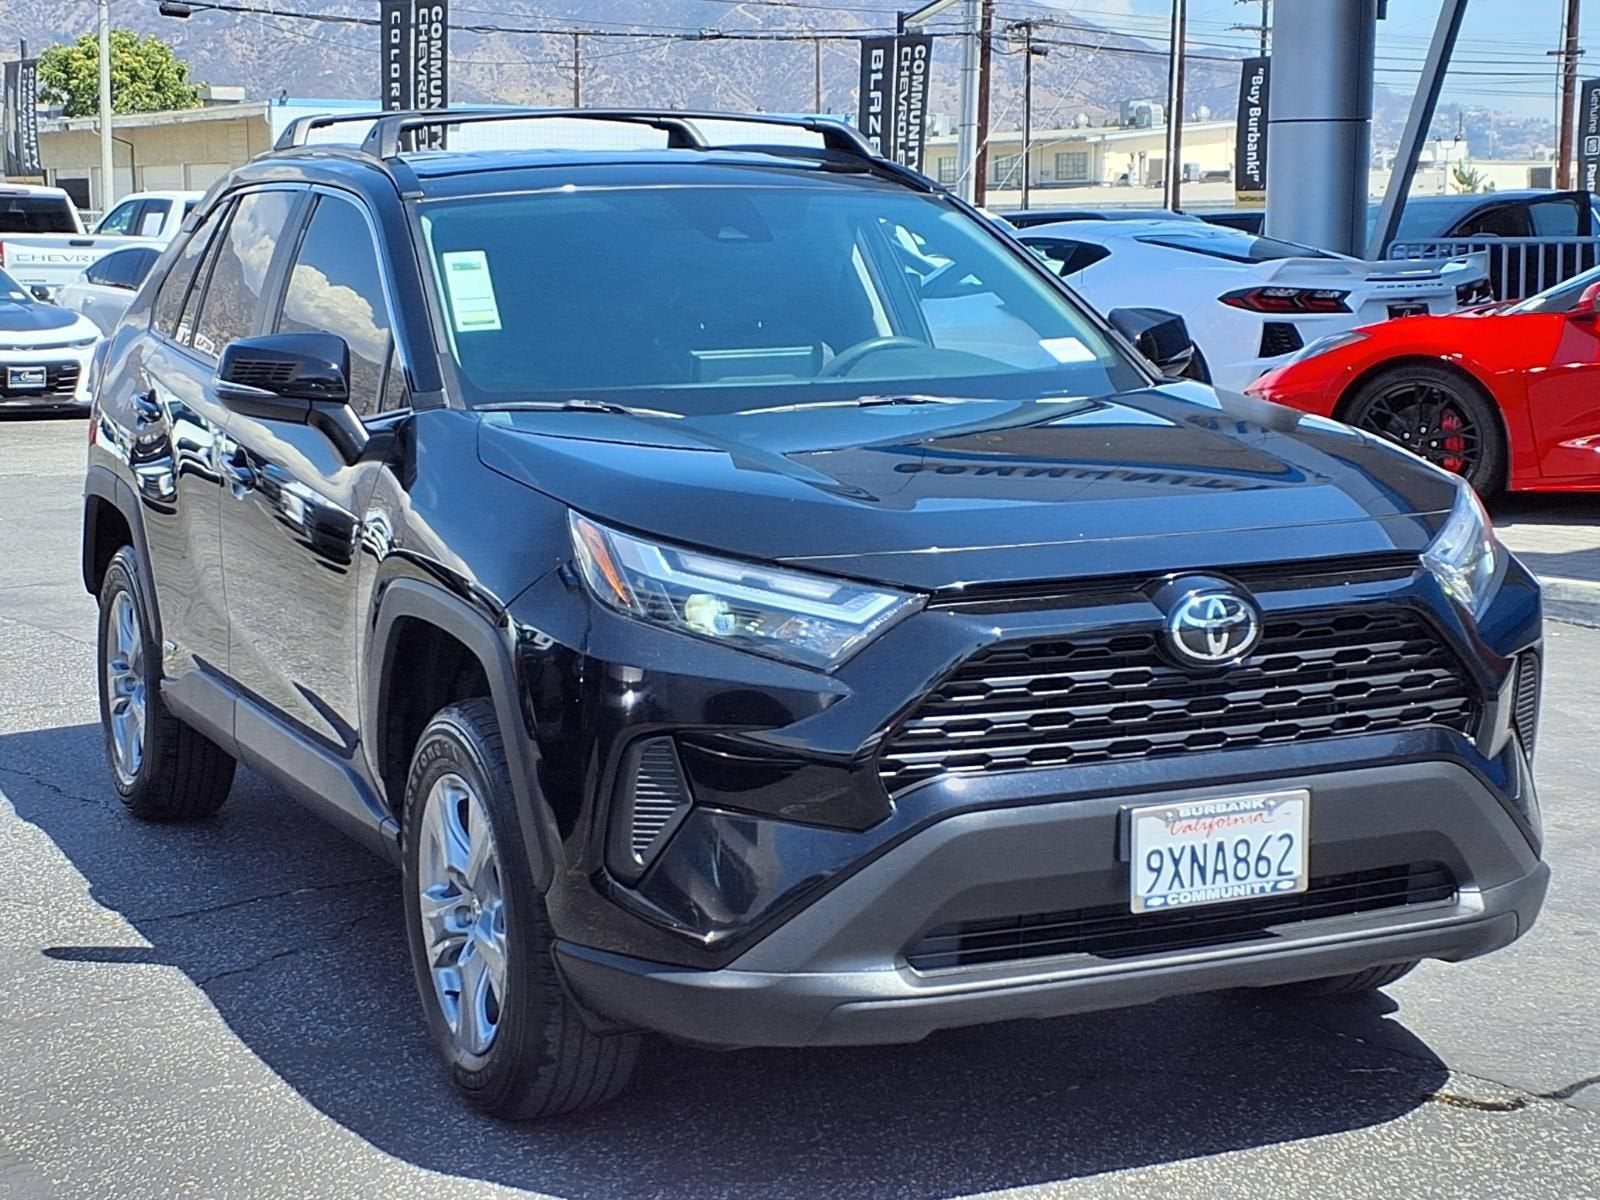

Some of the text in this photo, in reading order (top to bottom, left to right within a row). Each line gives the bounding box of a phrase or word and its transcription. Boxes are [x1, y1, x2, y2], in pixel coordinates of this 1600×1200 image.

[28, 66, 40, 169] COMMUNITY
[417, 8, 429, 151] CHEVROET
[430, 5, 443, 151] COMMUNTY
[896, 46, 912, 166] CHEVROLE
[907, 44, 927, 172] COMMUNITY
[1169, 812, 1274, 838] California
[1179, 800, 1266, 817] BURBANK
[1146, 832, 1294, 894] 9XNA862
[1167, 881, 1273, 905] COMMUNITY
